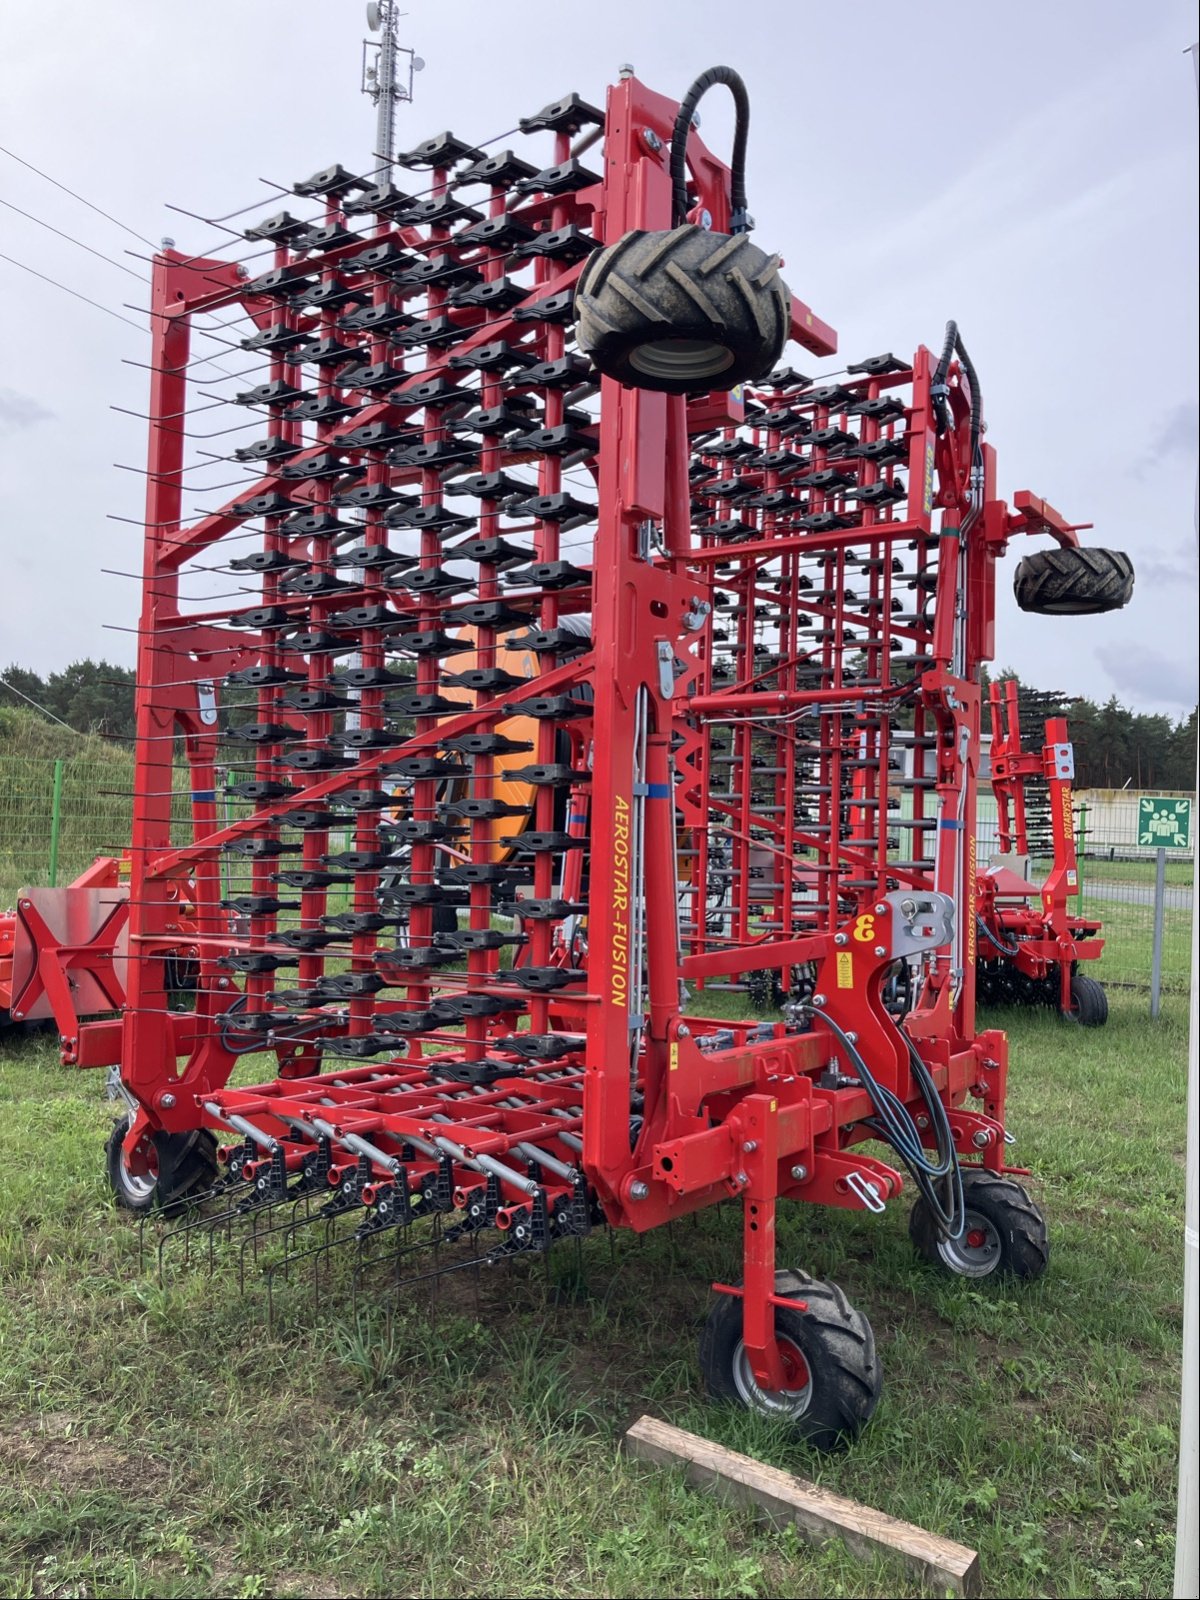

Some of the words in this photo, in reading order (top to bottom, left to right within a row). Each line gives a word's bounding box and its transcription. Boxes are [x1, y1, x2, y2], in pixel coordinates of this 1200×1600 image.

[1061, 786, 1073, 840] ROTARYSTAR
[611, 795, 630, 1007] AEROSTAR-FUSION
[967, 834, 976, 966] AEROSTAR-FUSION
